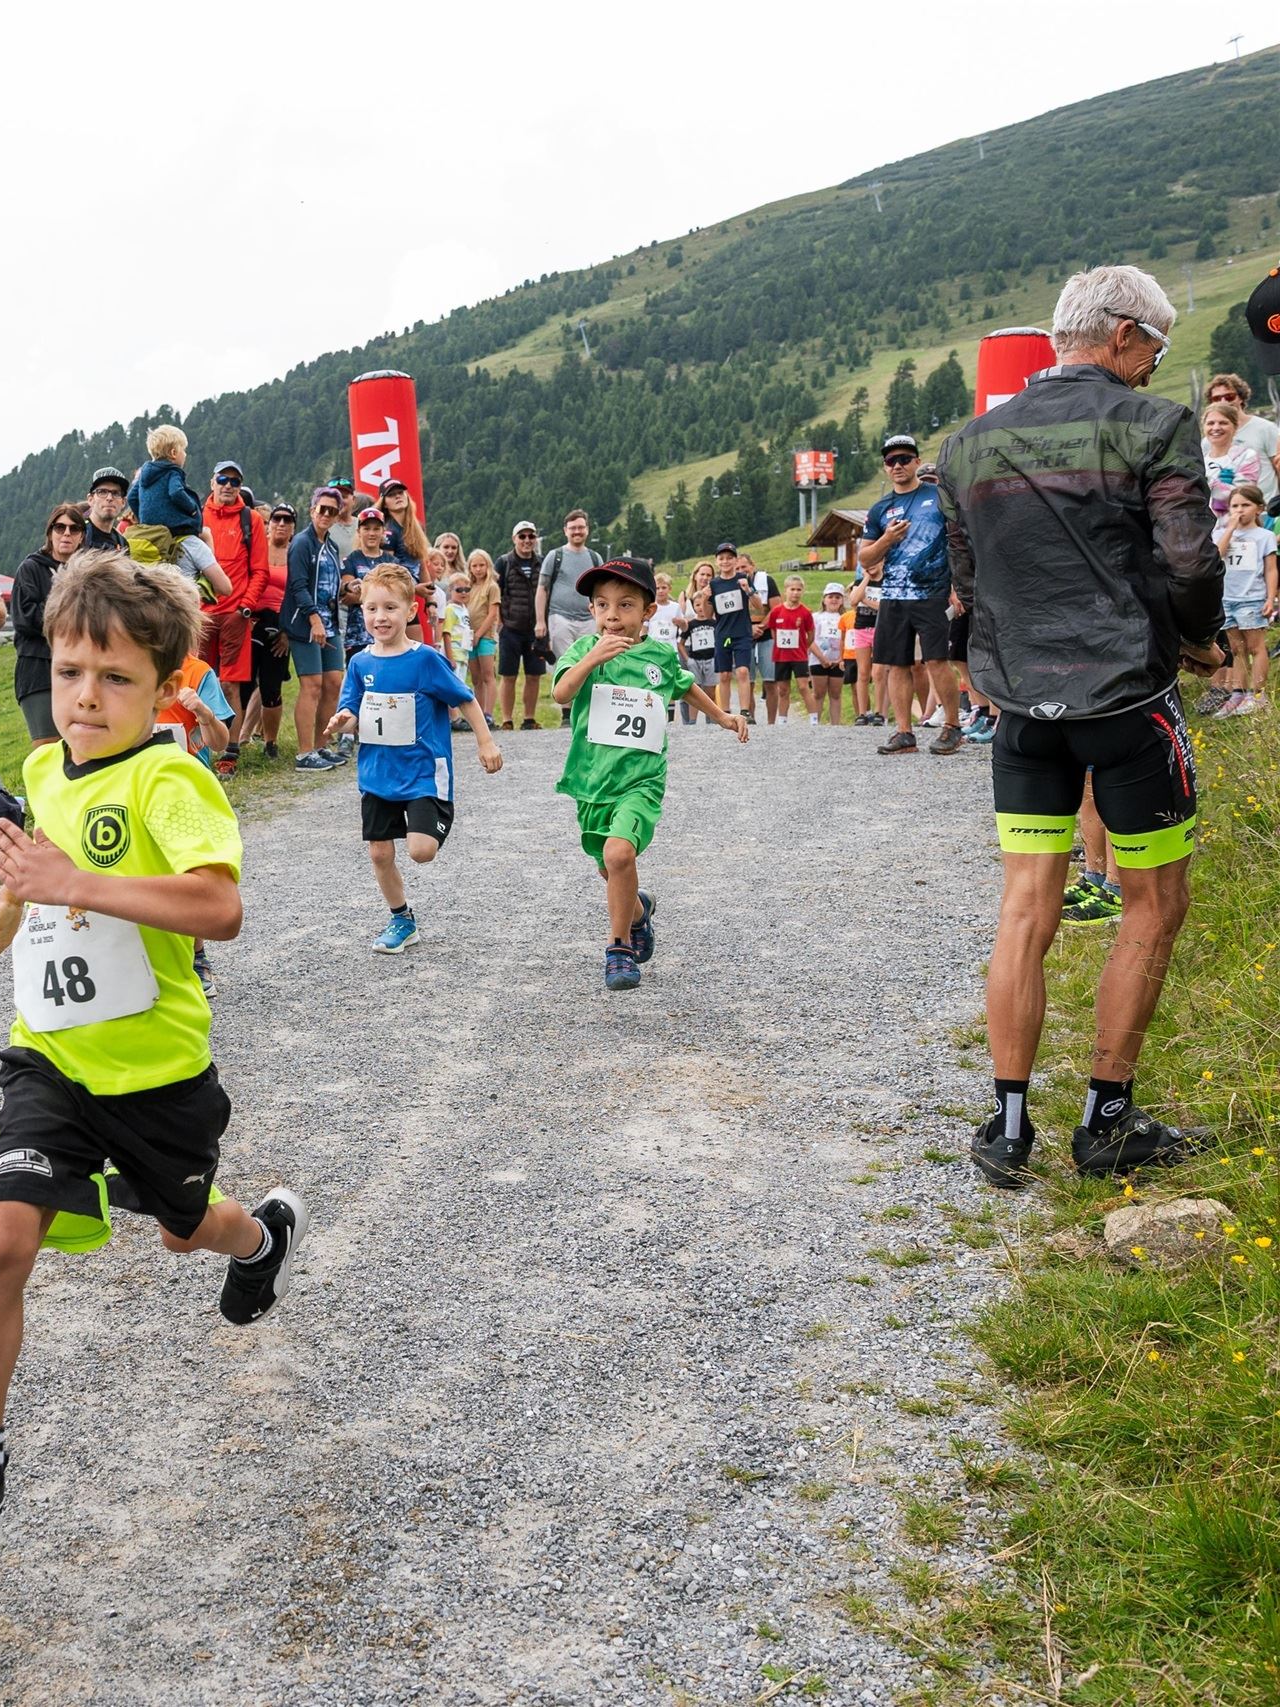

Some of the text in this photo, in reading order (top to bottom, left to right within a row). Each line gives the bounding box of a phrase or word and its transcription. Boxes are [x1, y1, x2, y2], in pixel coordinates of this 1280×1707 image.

[1228, 555, 1243, 566] 17
[724, 600, 735, 609] 69
[374, 717, 383, 736] 1
[614, 714, 646, 738] 29
[43, 956, 96, 1006] 48
